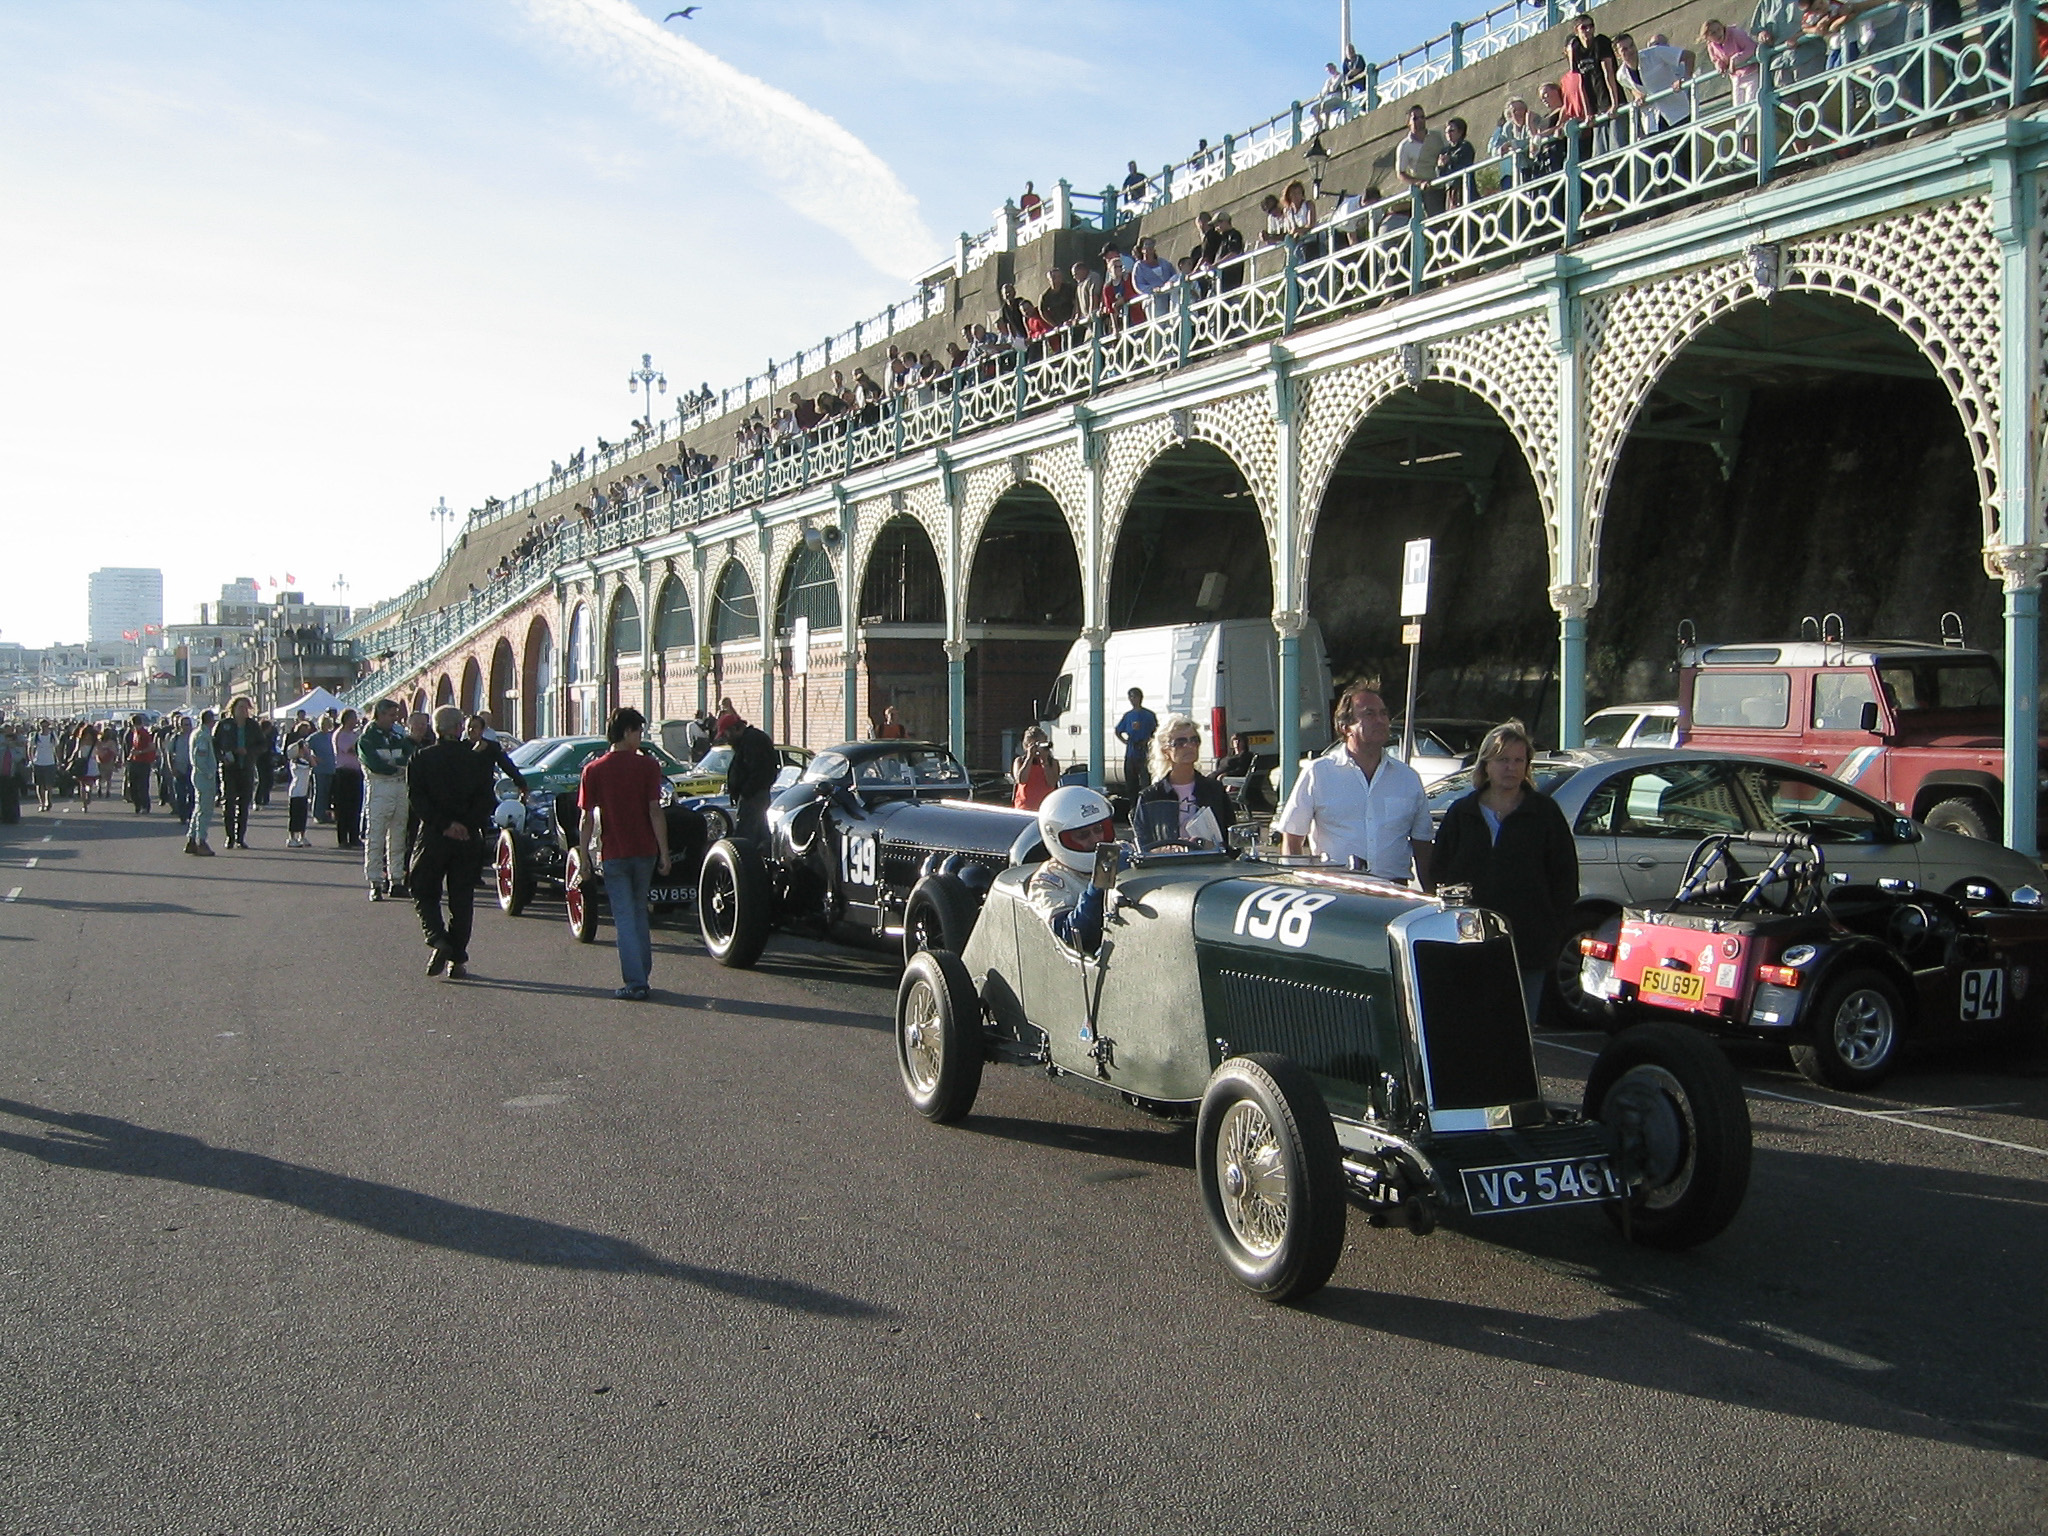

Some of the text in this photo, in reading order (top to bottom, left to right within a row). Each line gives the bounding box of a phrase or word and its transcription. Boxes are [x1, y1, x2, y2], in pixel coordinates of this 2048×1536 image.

[1408, 545, 1425, 583] P
[841, 834, 876, 886] 199
[650, 887, 698, 901] SV 859
[1233, 885, 1337, 948] 198
[1643, 970, 1671, 991] FSU
[1672, 975, 1700, 996] 697
[1963, 970, 1999, 1020] 94
[1477, 1161, 1615, 1206] VC 5461
